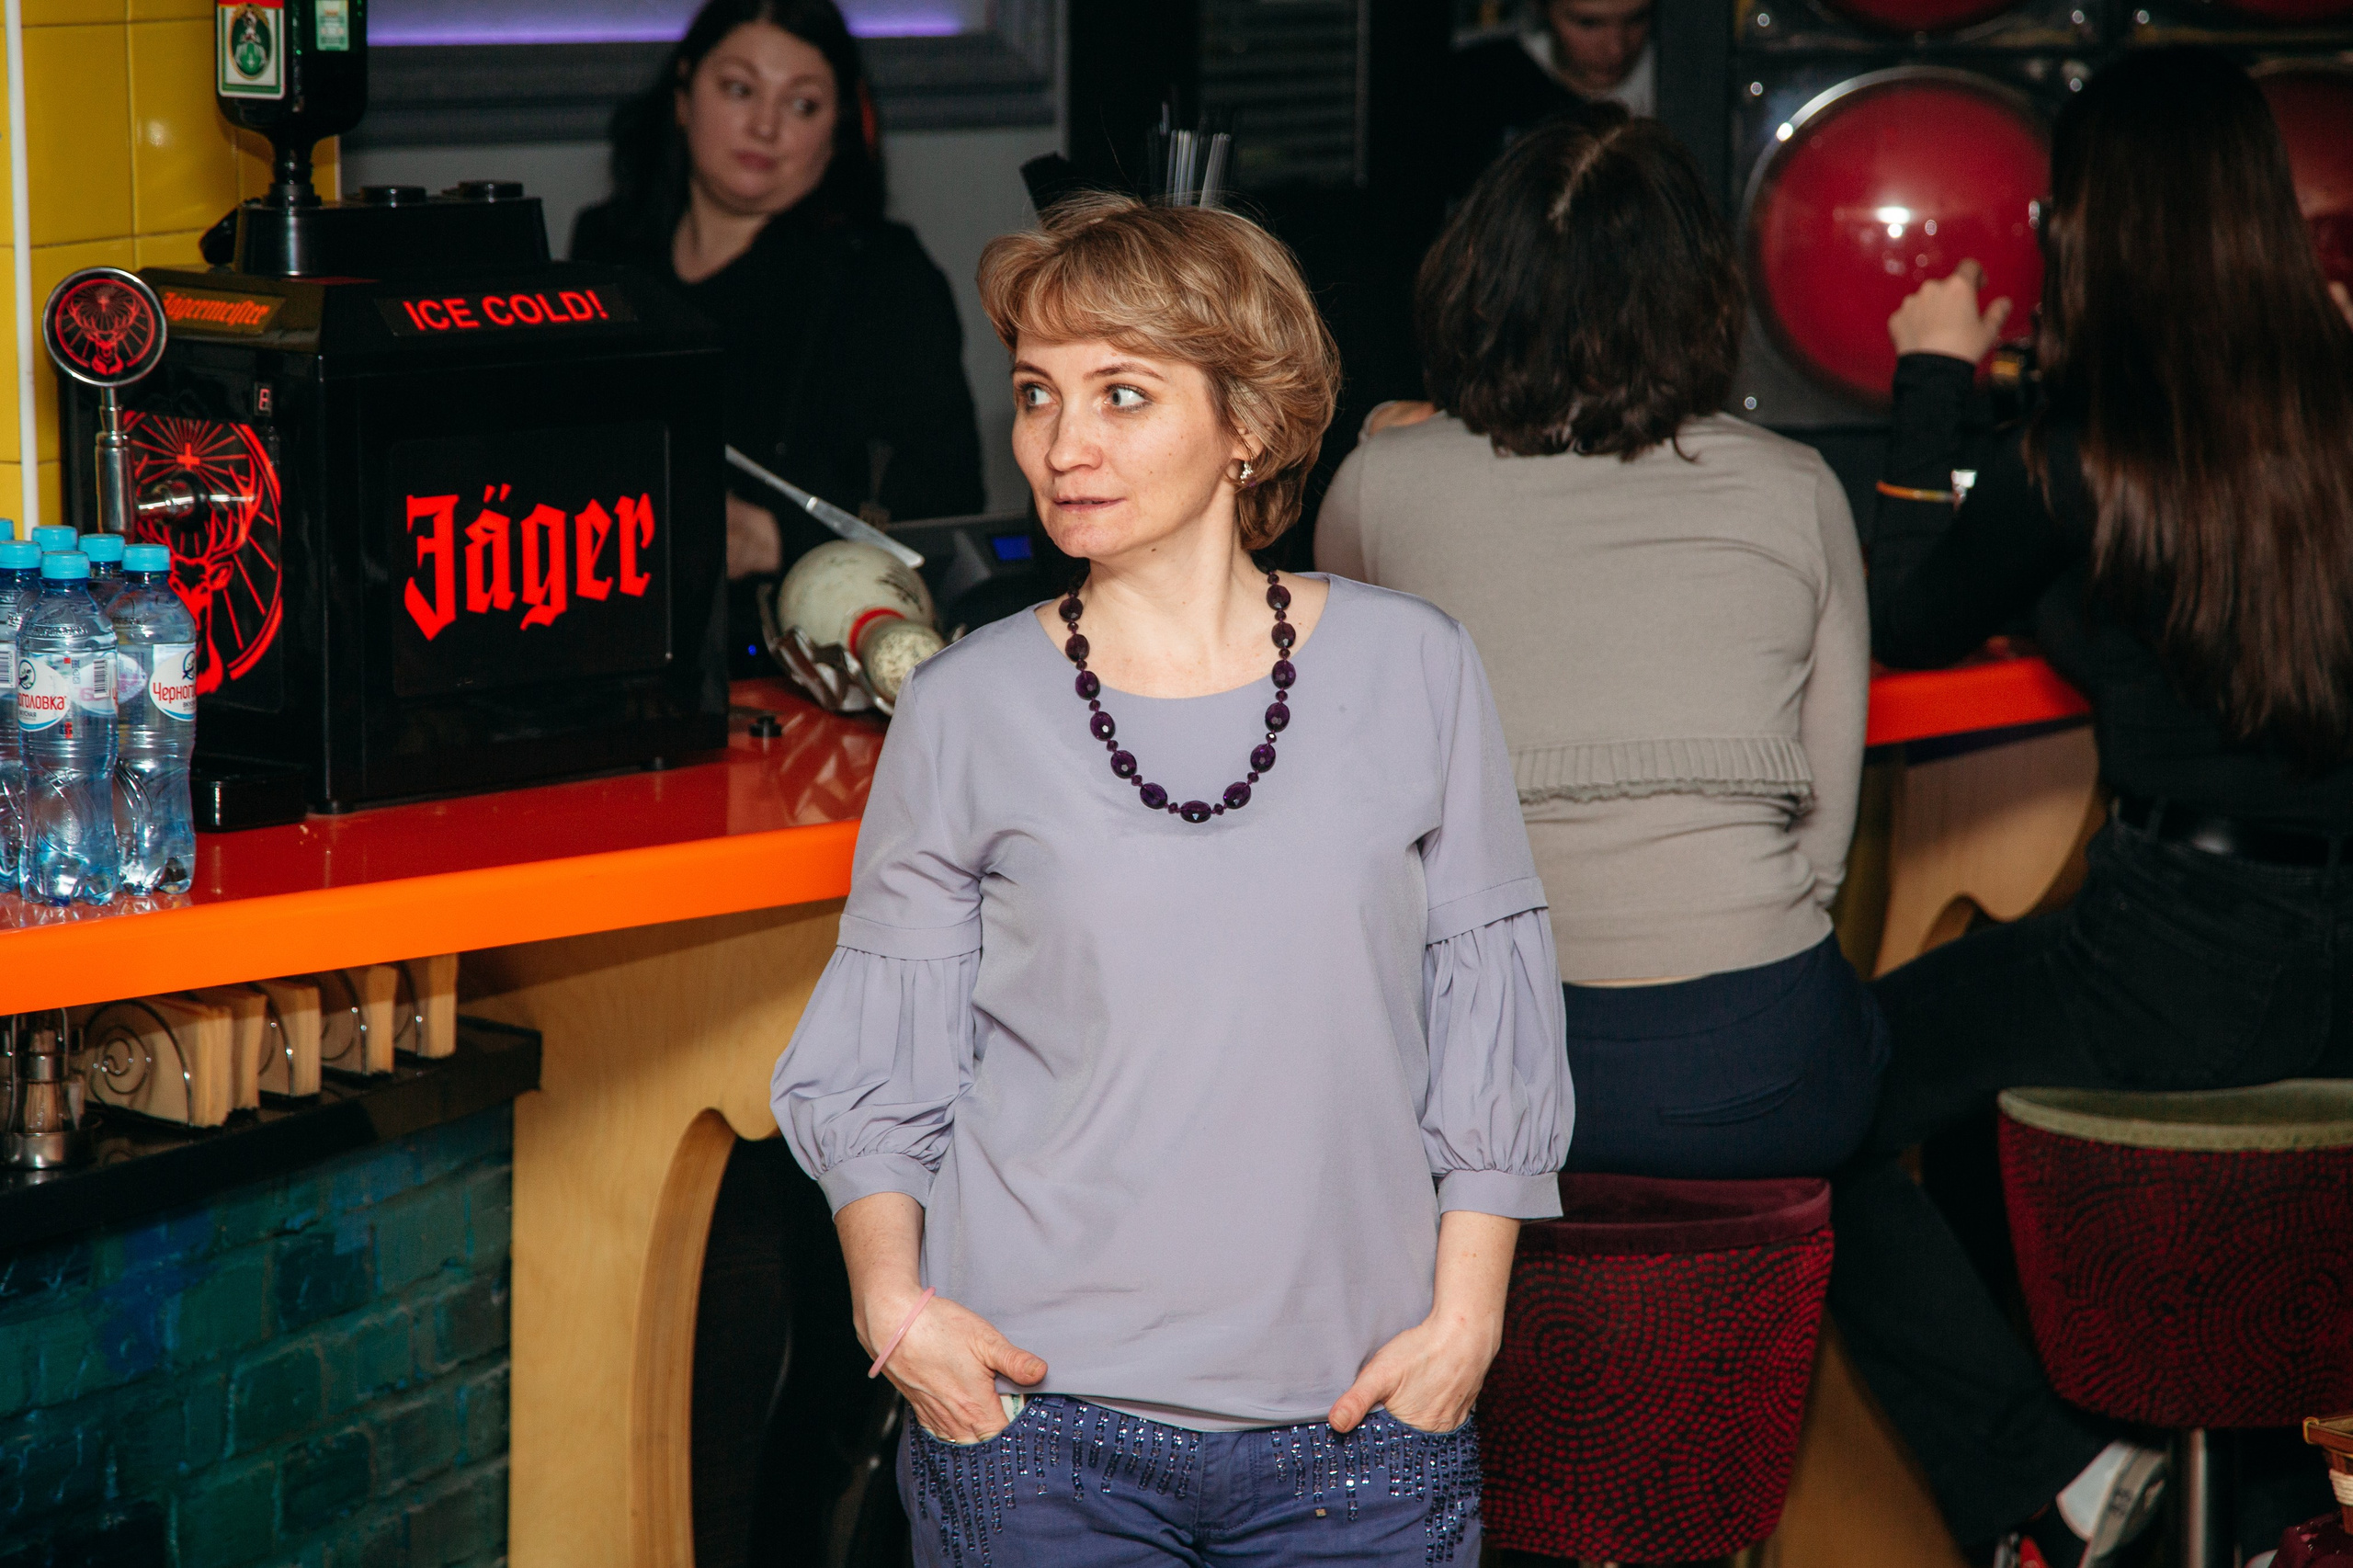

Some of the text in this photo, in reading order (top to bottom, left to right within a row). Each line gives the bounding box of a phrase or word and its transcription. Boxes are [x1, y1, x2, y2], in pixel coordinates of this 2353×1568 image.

[404, 290, 608, 330] ICE COLD!
[404, 483, 654, 641] Jäger
[17, 692, 65, 710] оголовка
